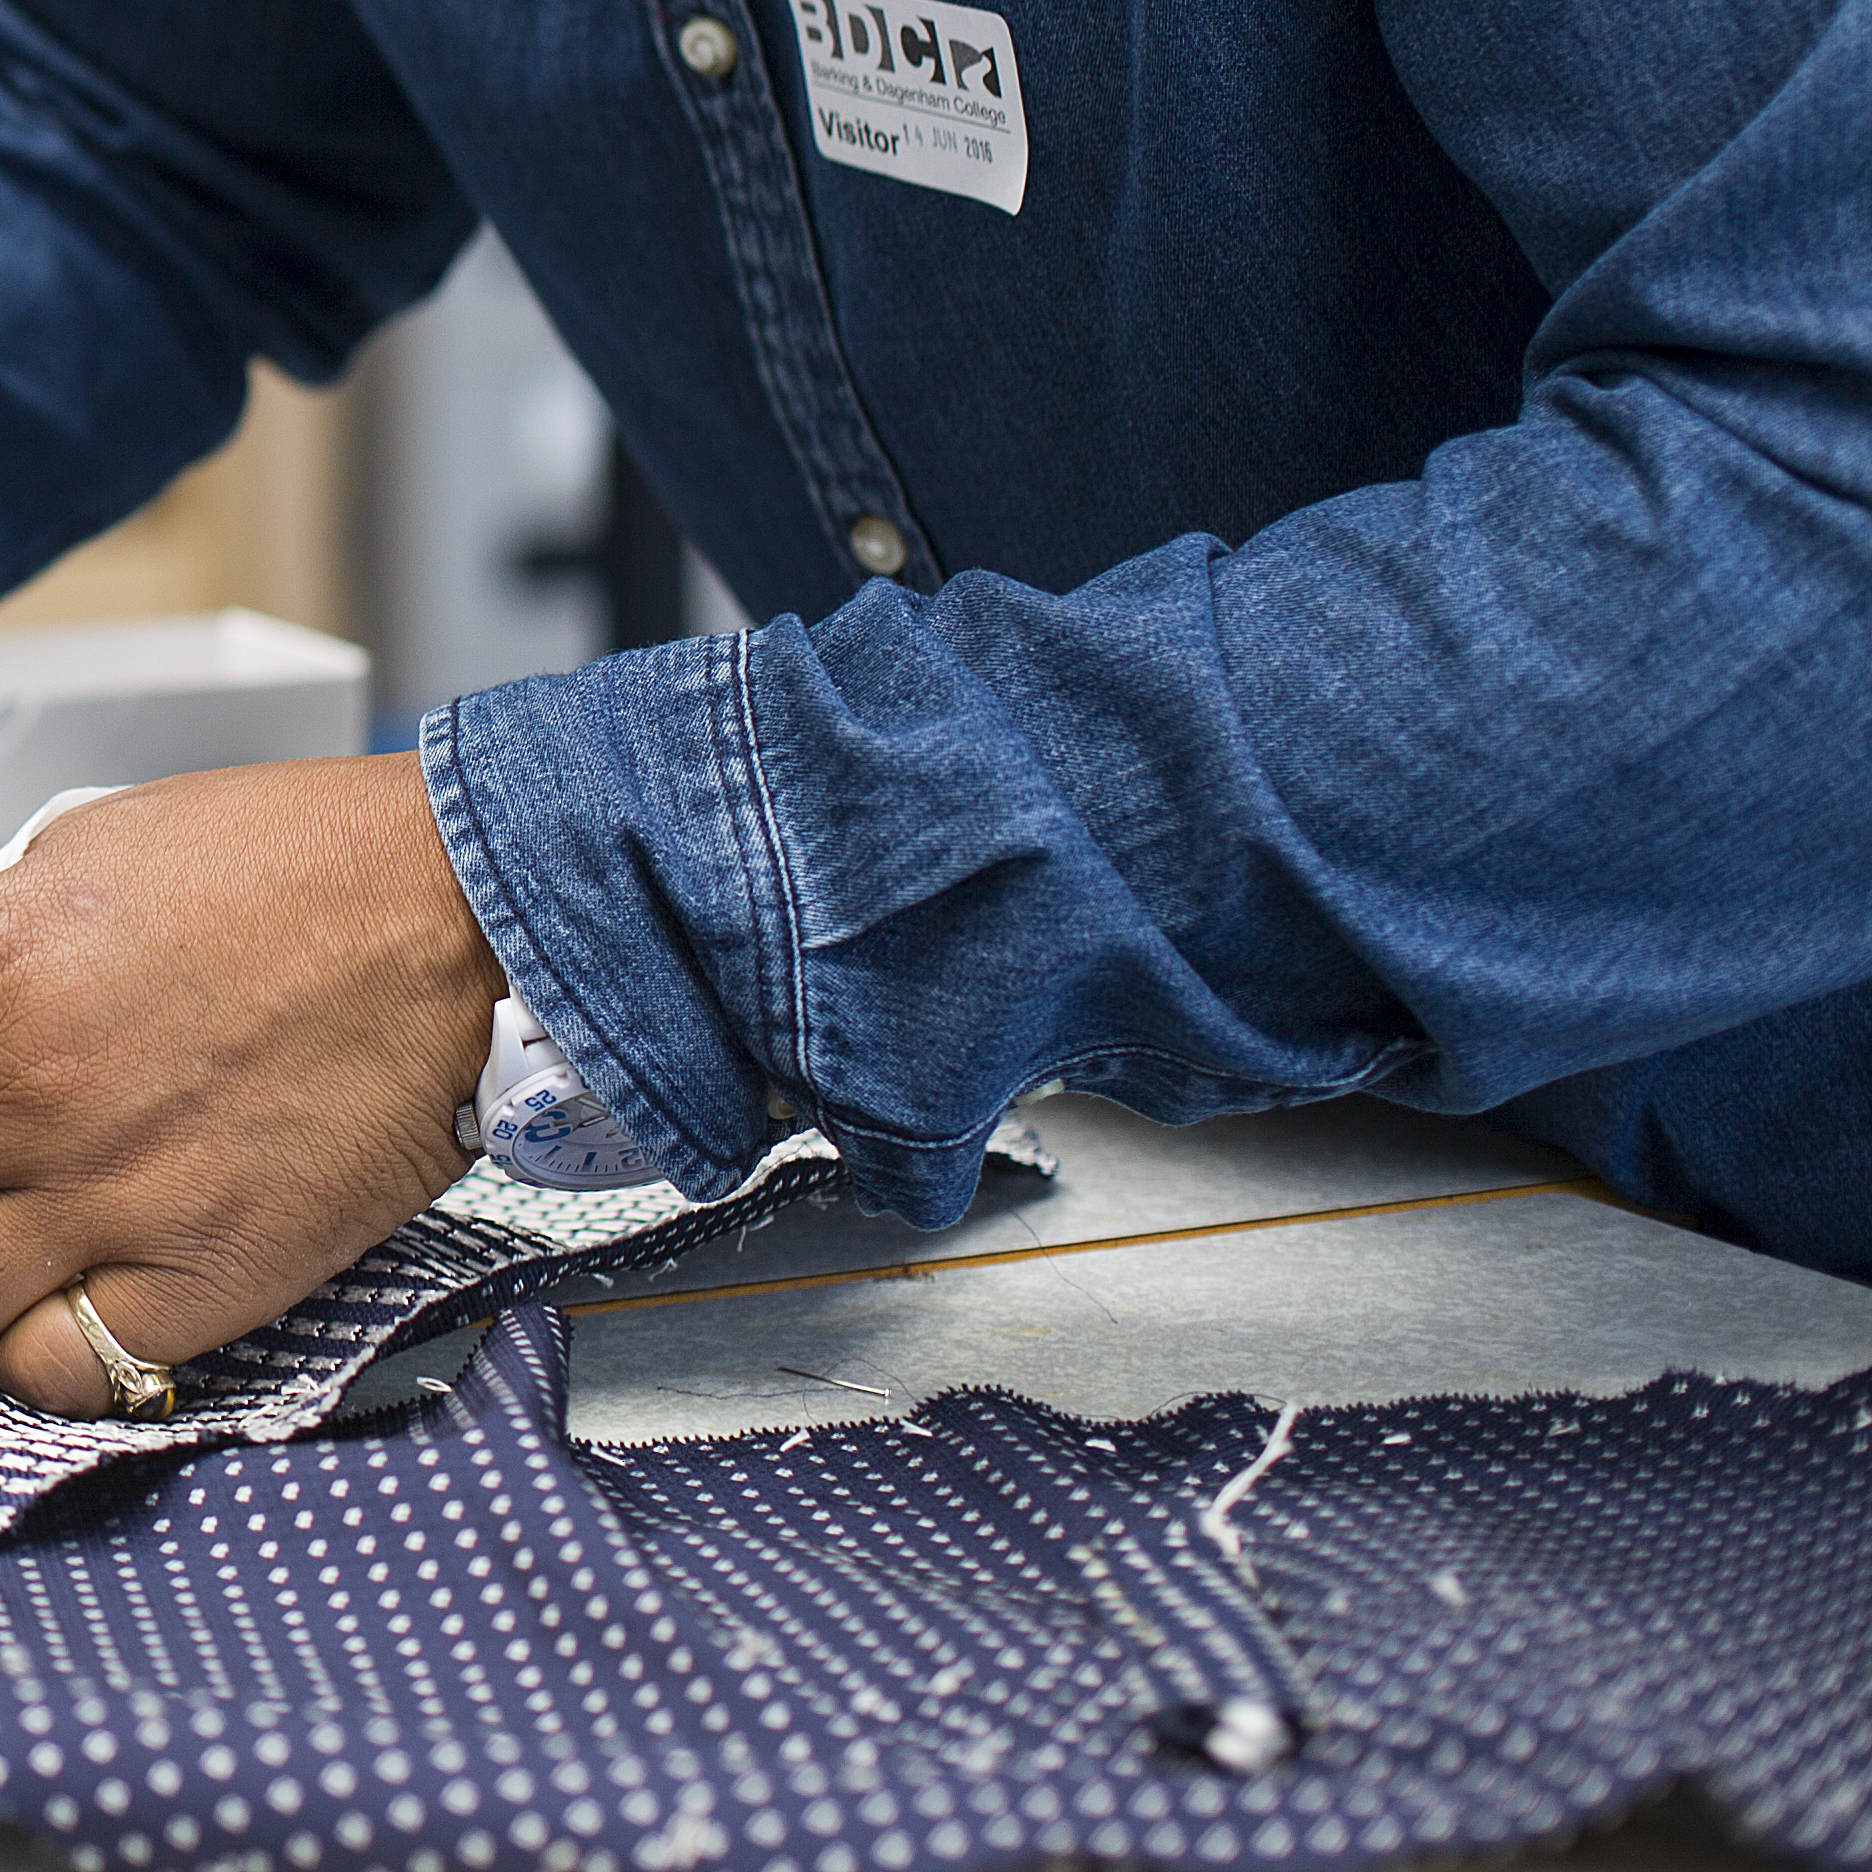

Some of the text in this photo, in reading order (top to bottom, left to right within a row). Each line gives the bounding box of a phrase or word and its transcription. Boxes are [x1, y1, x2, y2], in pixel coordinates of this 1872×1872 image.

[811, 60, 1006, 127] Barking & Dagenham College
[818, 107, 899, 156] Visitor
[932, 126, 958, 151] JUN
[964, 135, 992, 163] 2016
[525, 1089, 557, 1111] 25
[492, 1119, 518, 1141] 20
